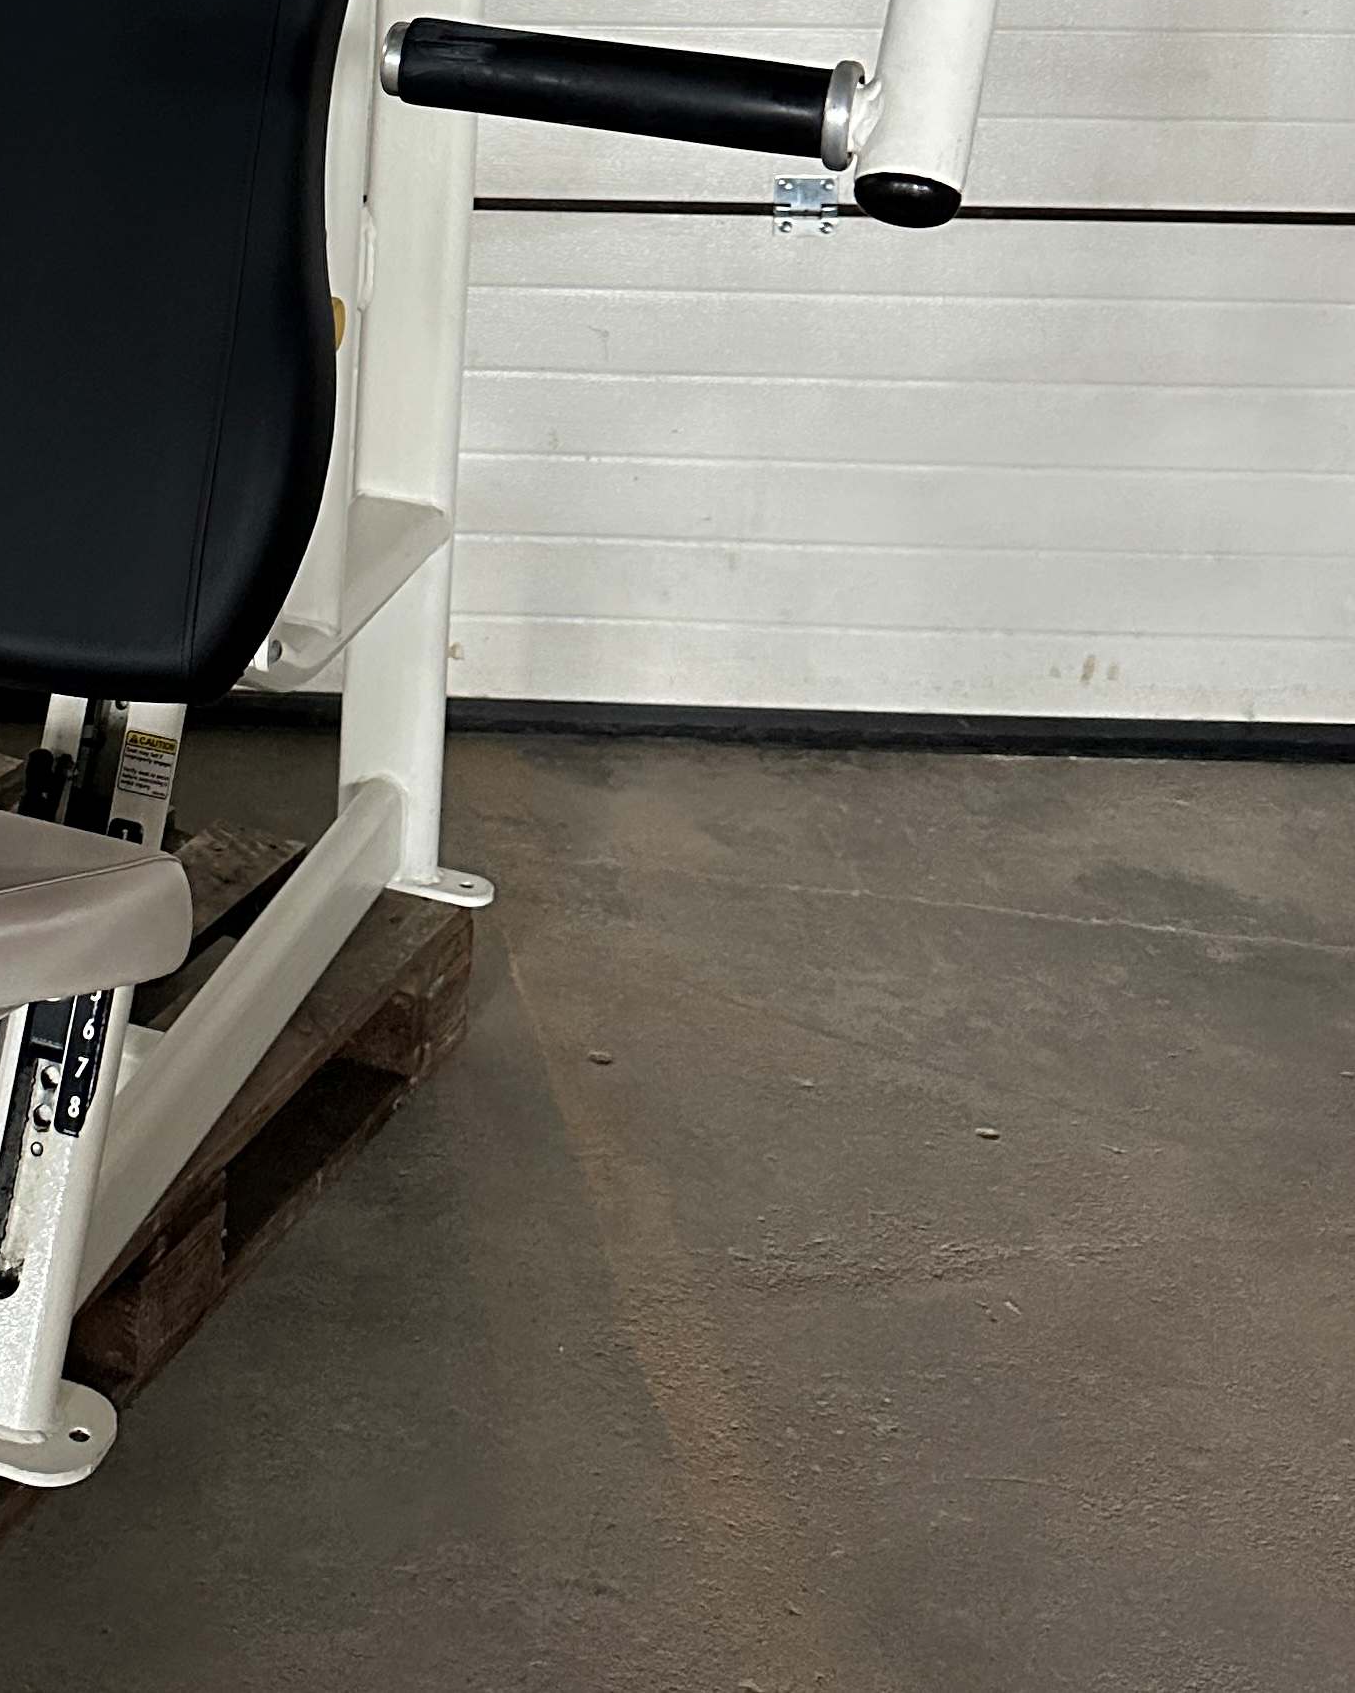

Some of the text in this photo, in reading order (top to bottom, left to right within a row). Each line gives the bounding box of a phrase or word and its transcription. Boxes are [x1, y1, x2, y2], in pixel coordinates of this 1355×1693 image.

[82, 1018, 95, 1040] 6
[75, 1056, 90, 1078] 7
[68, 1095, 81, 1119] 8
